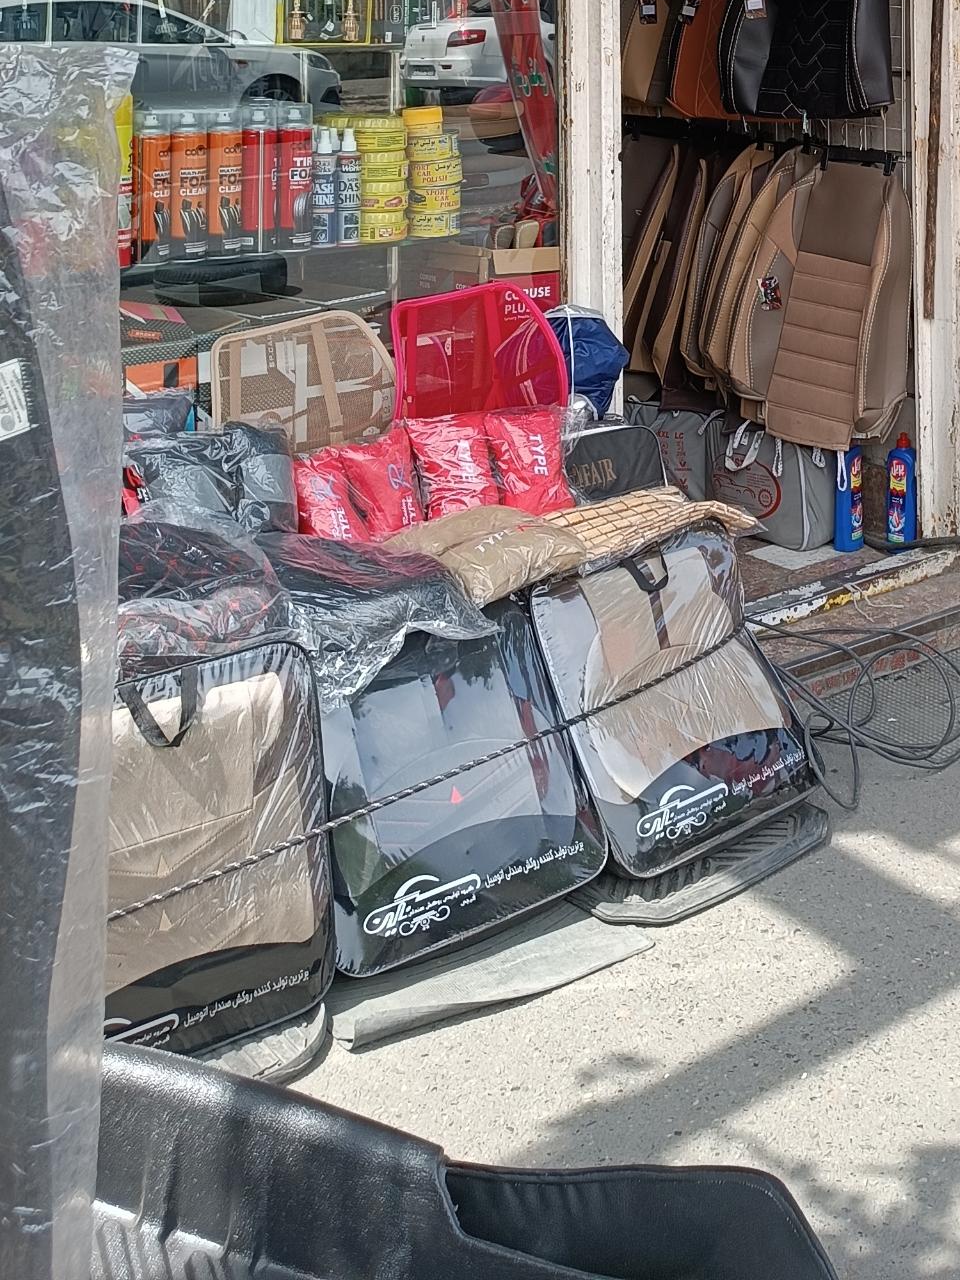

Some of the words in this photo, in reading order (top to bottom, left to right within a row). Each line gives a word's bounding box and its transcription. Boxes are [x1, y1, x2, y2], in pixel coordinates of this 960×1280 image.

[290, 169, 311, 180] FO
[313, 183, 334, 194] ASH
[338, 181, 360, 192] DAS
[312, 194, 335, 206] HINE
[528, 433, 549, 477] TYPE
[505, 863, 523, 881] صندلی
[523, 856, 541, 875] روکش
[272, 975, 289, 993] تولید
[289, 969, 310, 986] برترین
[232, 988, 253, 1009] روکش
[253, 980, 271, 999] کننده
[183, 1005, 209, 1028] اتومبیل
[209, 999, 232, 1019] صندلی
